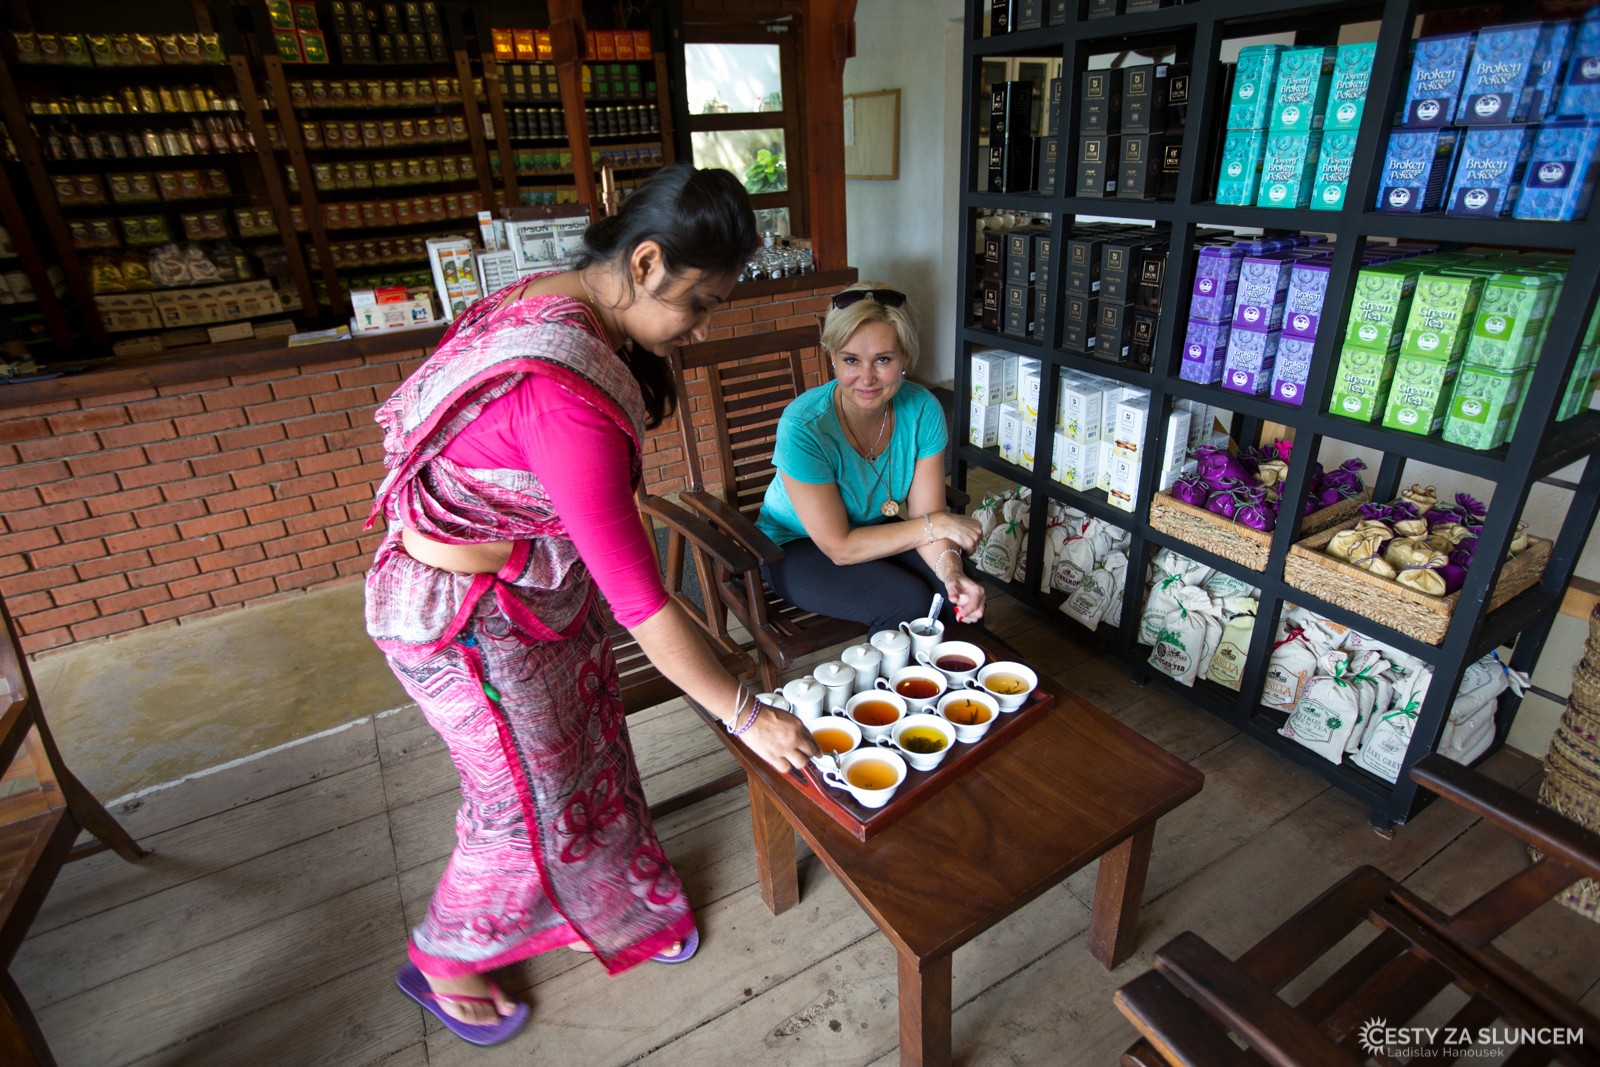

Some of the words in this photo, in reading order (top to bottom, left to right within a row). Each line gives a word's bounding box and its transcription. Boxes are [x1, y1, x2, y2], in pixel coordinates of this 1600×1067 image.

[517, 44, 533, 53] TEA
[1477, 62, 1521, 74] Broken
[1416, 69, 1455, 81] Broken
[1281, 84, 1309, 94] Broken
[1336, 80, 1367, 89] Broken
[1268, 164, 1295, 172] Broken
[1322, 164, 1350, 173] Broken
[1389, 159, 1426, 170] Broken
[1466, 158, 1508, 170] Broken
[1359, 300, 1392, 312] Green
[1364, 309, 1382, 321] Tea
[1418, 306, 1456, 320] Green
[1424, 316, 1444, 329] Tea
[1343, 372, 1375, 386] Green
[1348, 382, 1365, 394] Tea
[1398, 383, 1434, 397] Green
[1404, 393, 1422, 405] Tea
[1173, 664, 1185, 673] TEA
[1366, 747, 1382, 762] EARL
